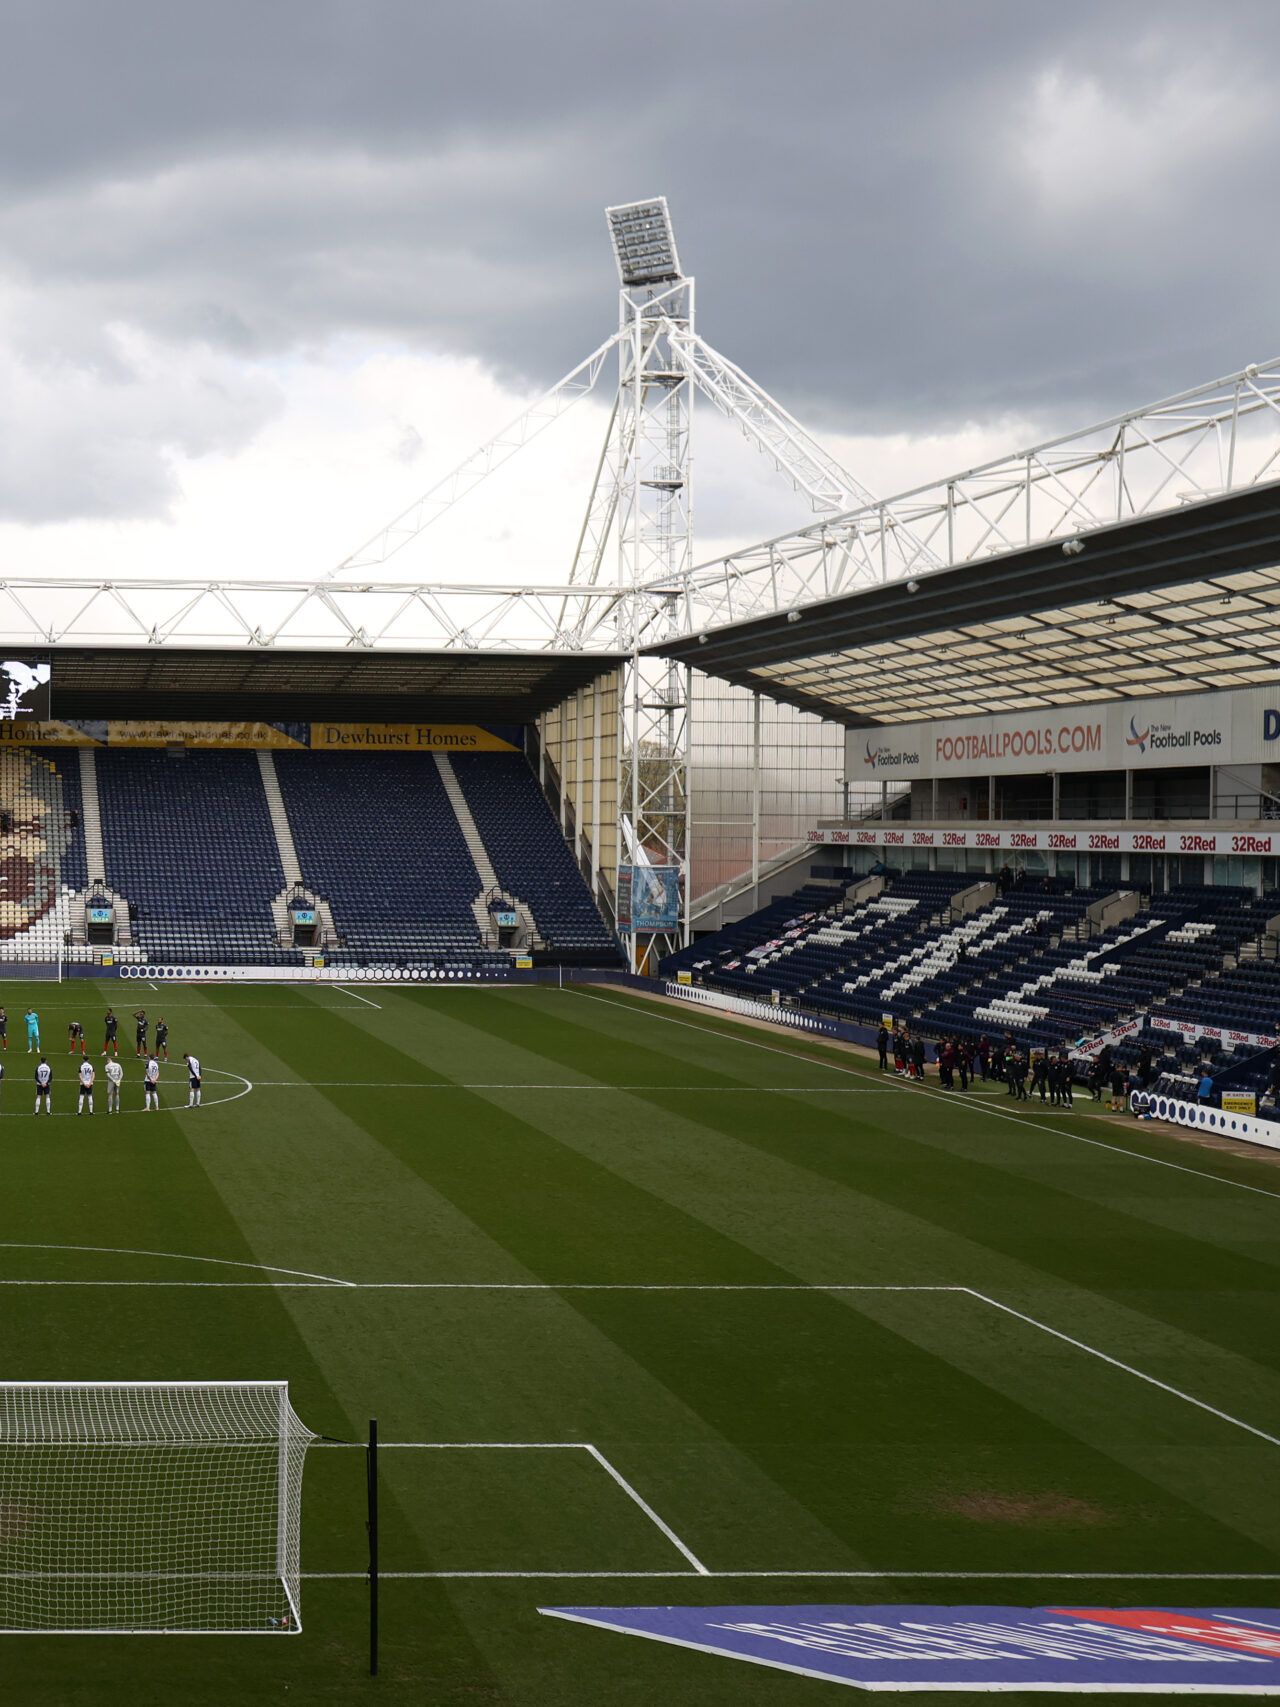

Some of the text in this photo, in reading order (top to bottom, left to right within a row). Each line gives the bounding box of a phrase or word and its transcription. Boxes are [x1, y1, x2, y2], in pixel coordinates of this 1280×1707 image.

[326, 727, 478, 746] Dewhurst Homes
[1150, 724, 1159, 732] The
[935, 724, 1102, 762] FOOTBALLPOOLS.COM
[1150, 729, 1222, 749] Football Pools
[878, 751, 919, 766] Football Pools
[807, 831, 1272, 852] 32Red 32Red 32Red 32Red 32Red 32Red 32Red 32Red 32Red 32Red 32Red 32Red 32Red
[1076, 1021, 1138, 1055] 32Red 32Red
[1152, 1018, 1170, 1029] 32Red
[1176, 1022, 1196, 1034] 32Red
[1202, 1027, 1222, 1038] 32Red
[1228, 1031, 1249, 1043] 32Red
[40, 1070, 48, 1078] 17
